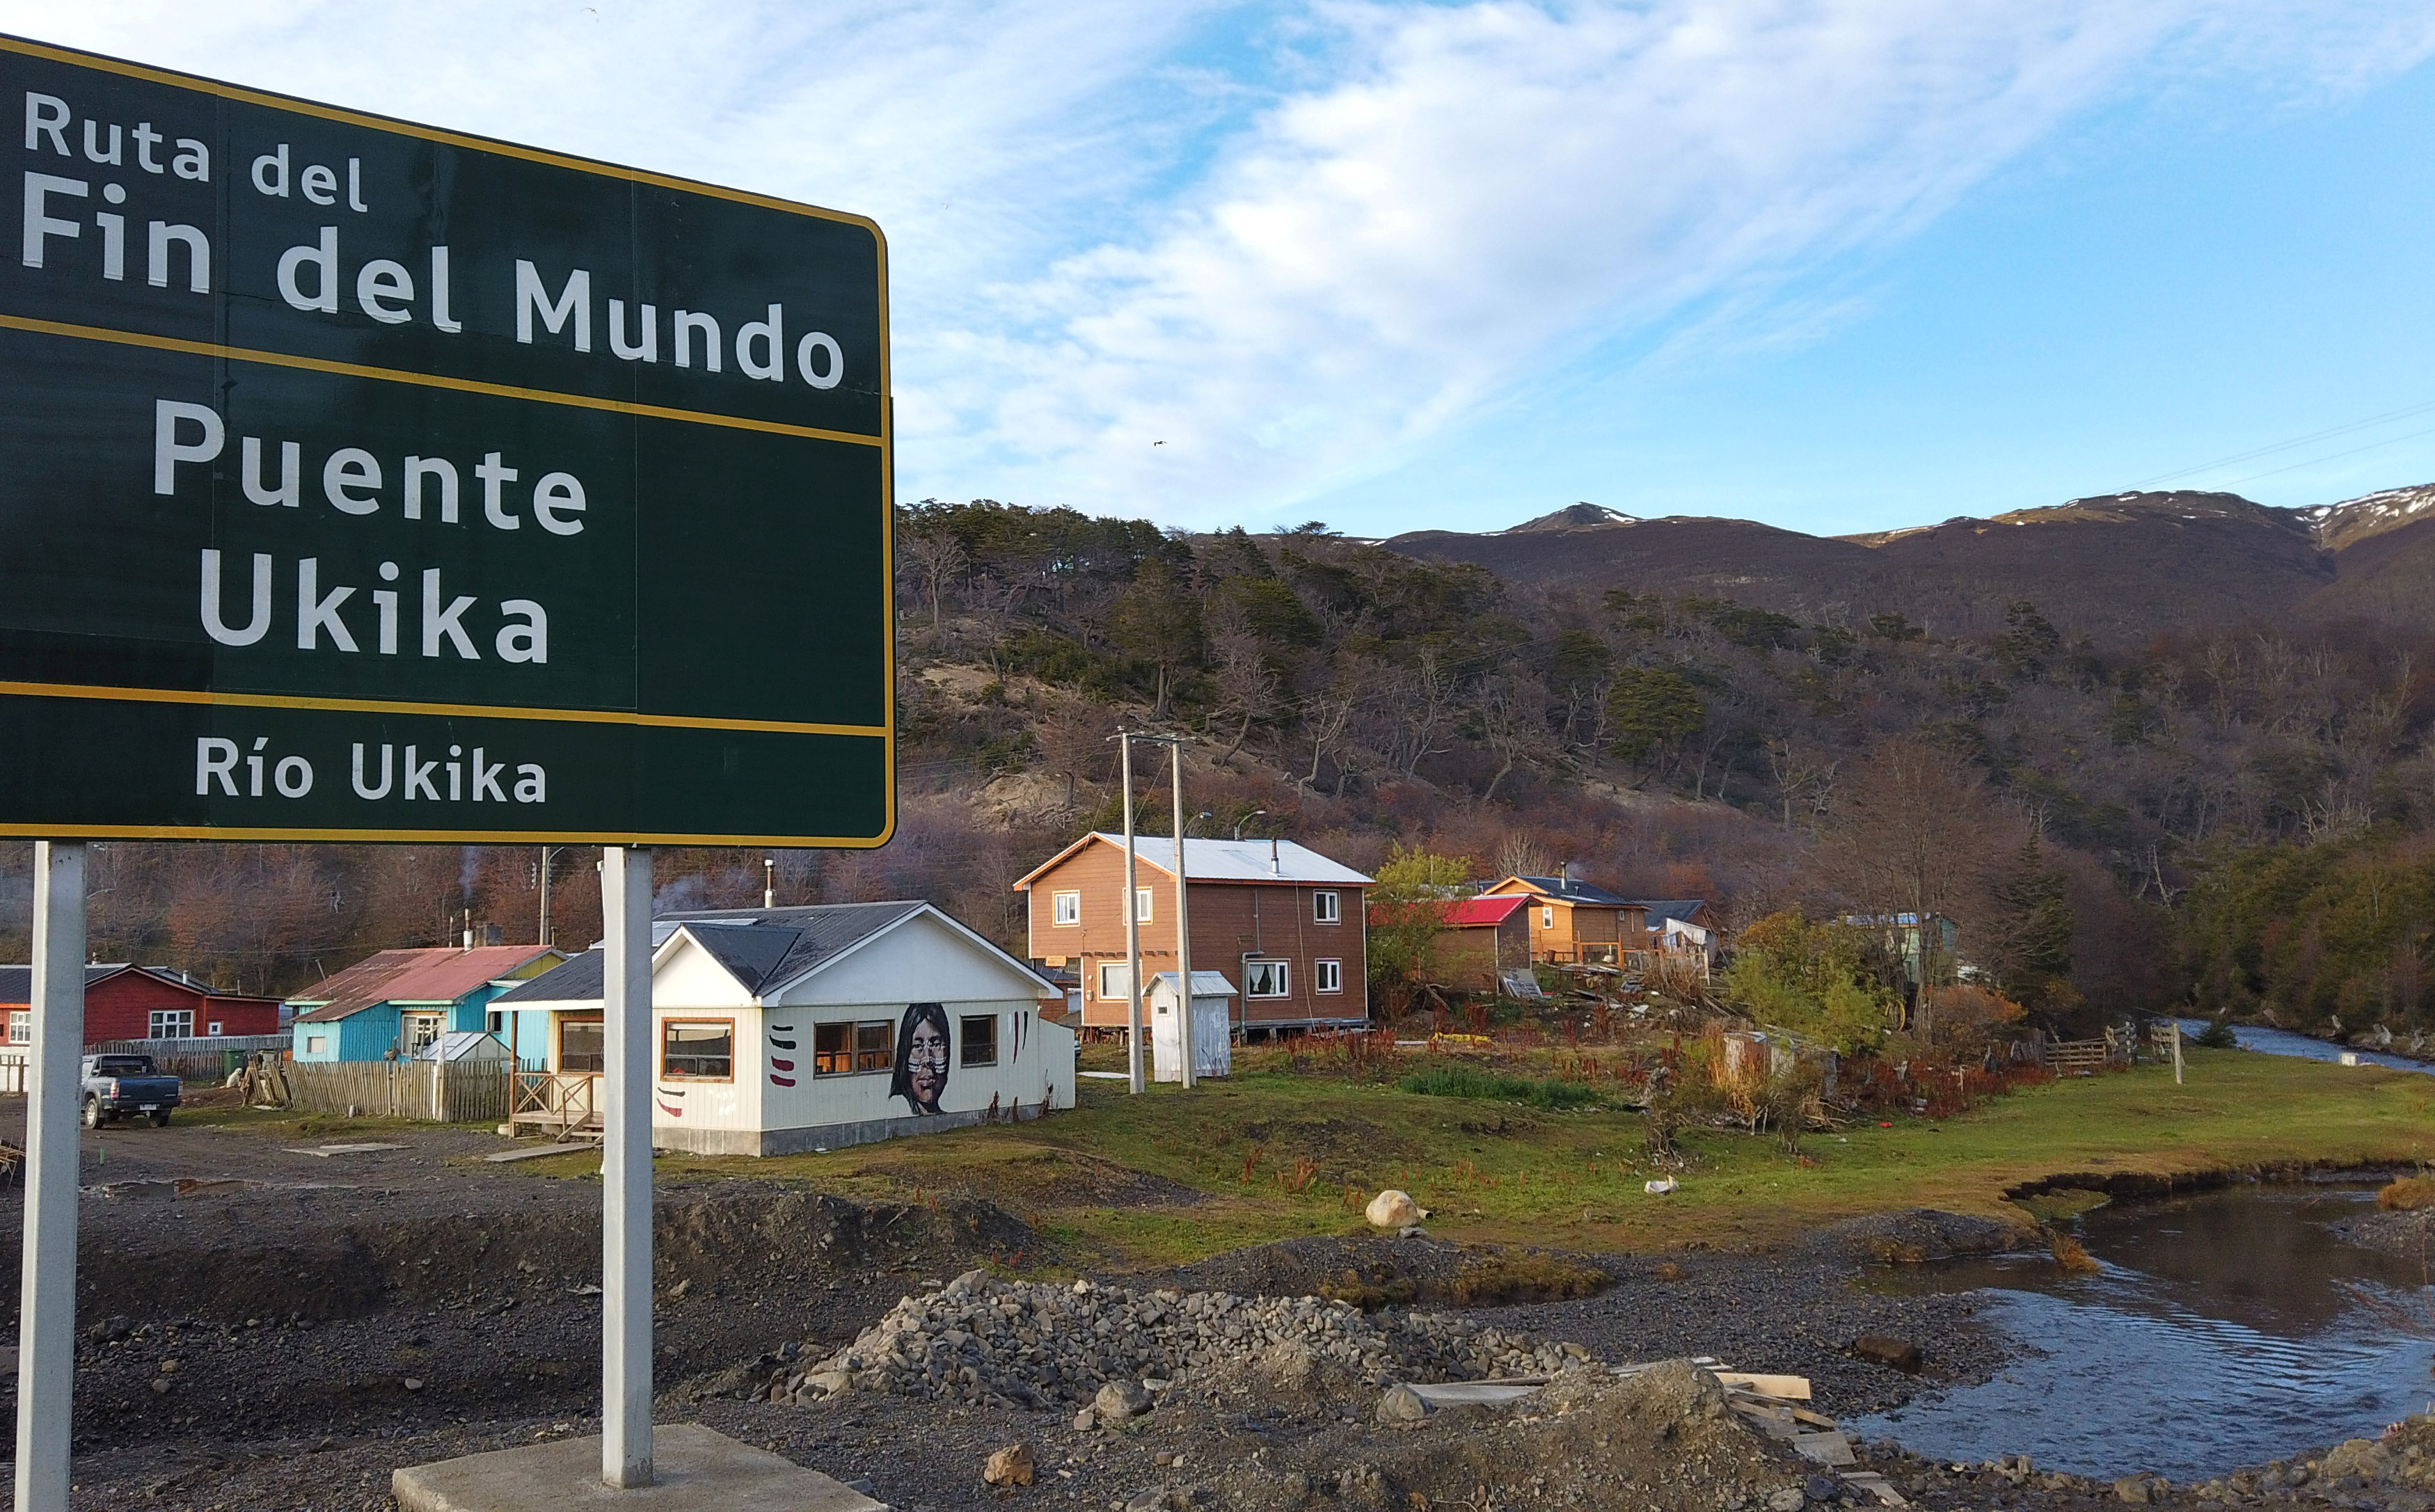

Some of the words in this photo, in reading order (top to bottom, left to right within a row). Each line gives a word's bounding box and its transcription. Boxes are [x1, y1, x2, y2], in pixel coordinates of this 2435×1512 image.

[25, 91, 210, 183] Ruta
[251, 143, 368, 213] del
[22, 170, 211, 295] Fin
[277, 225, 462, 333] del
[516, 258, 844, 390] Mundo
[154, 399, 587, 536] Puente
[200, 548, 548, 665] Ukika
[196, 736, 313, 799] Río
[351, 742, 546, 803] Ukika
